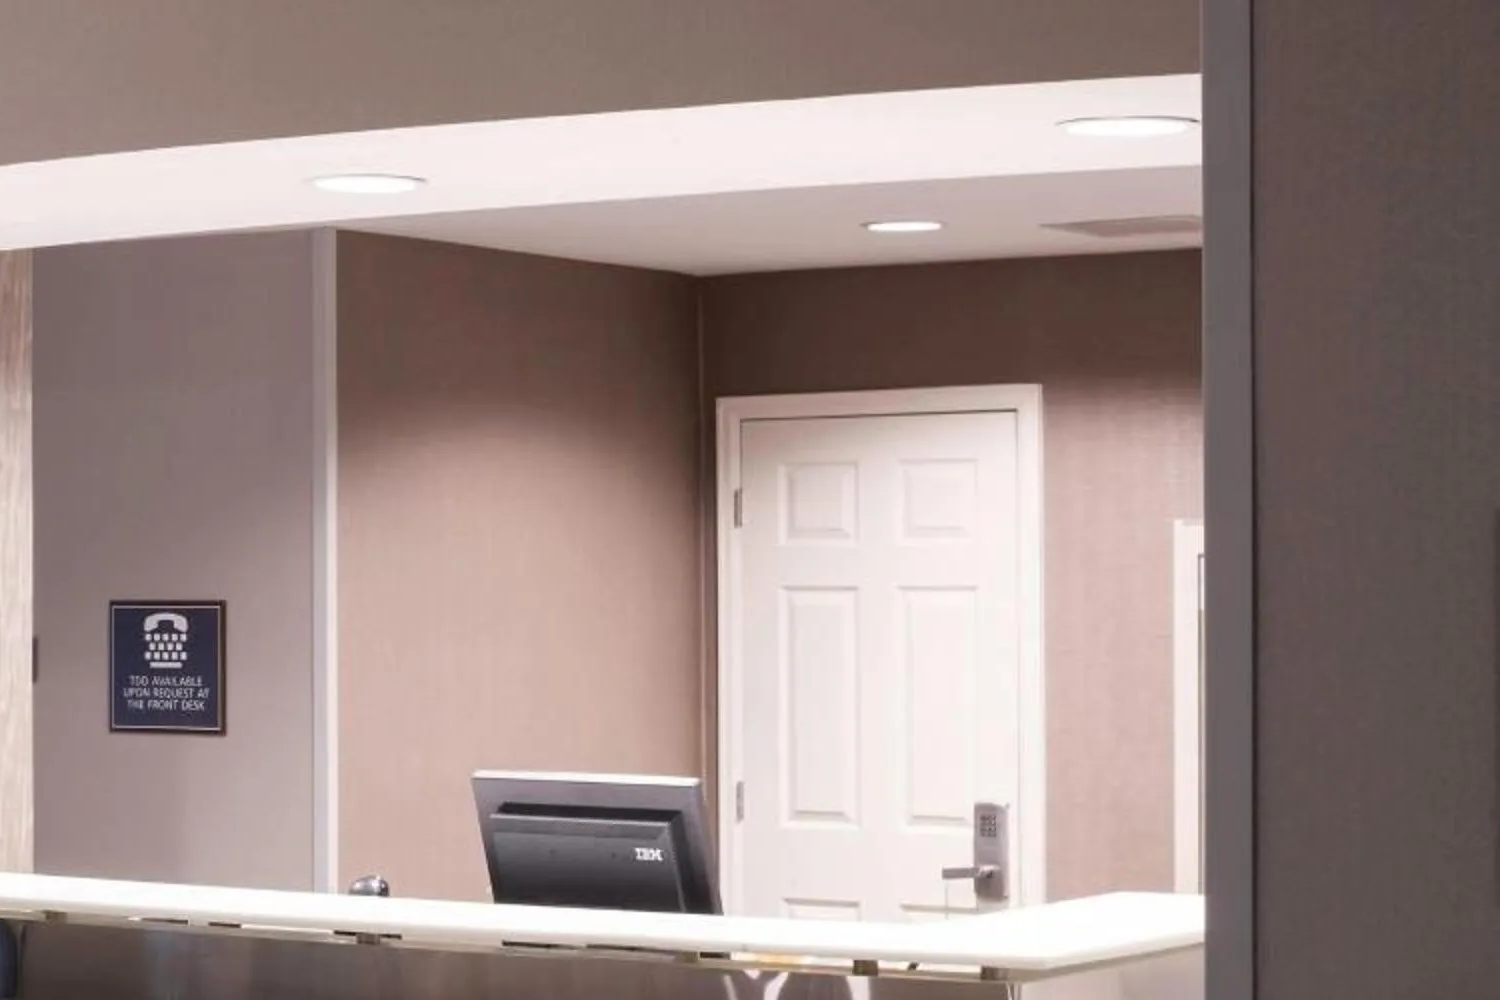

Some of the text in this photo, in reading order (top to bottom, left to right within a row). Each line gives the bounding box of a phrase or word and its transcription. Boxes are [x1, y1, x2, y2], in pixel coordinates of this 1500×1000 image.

[152, 675, 203, 687] AVAILABLE
[123, 687, 210, 699] UPON REQUEST AT
[127, 699, 205, 711] THE FRONT DESK
[634, 847, 664, 861] IBM
